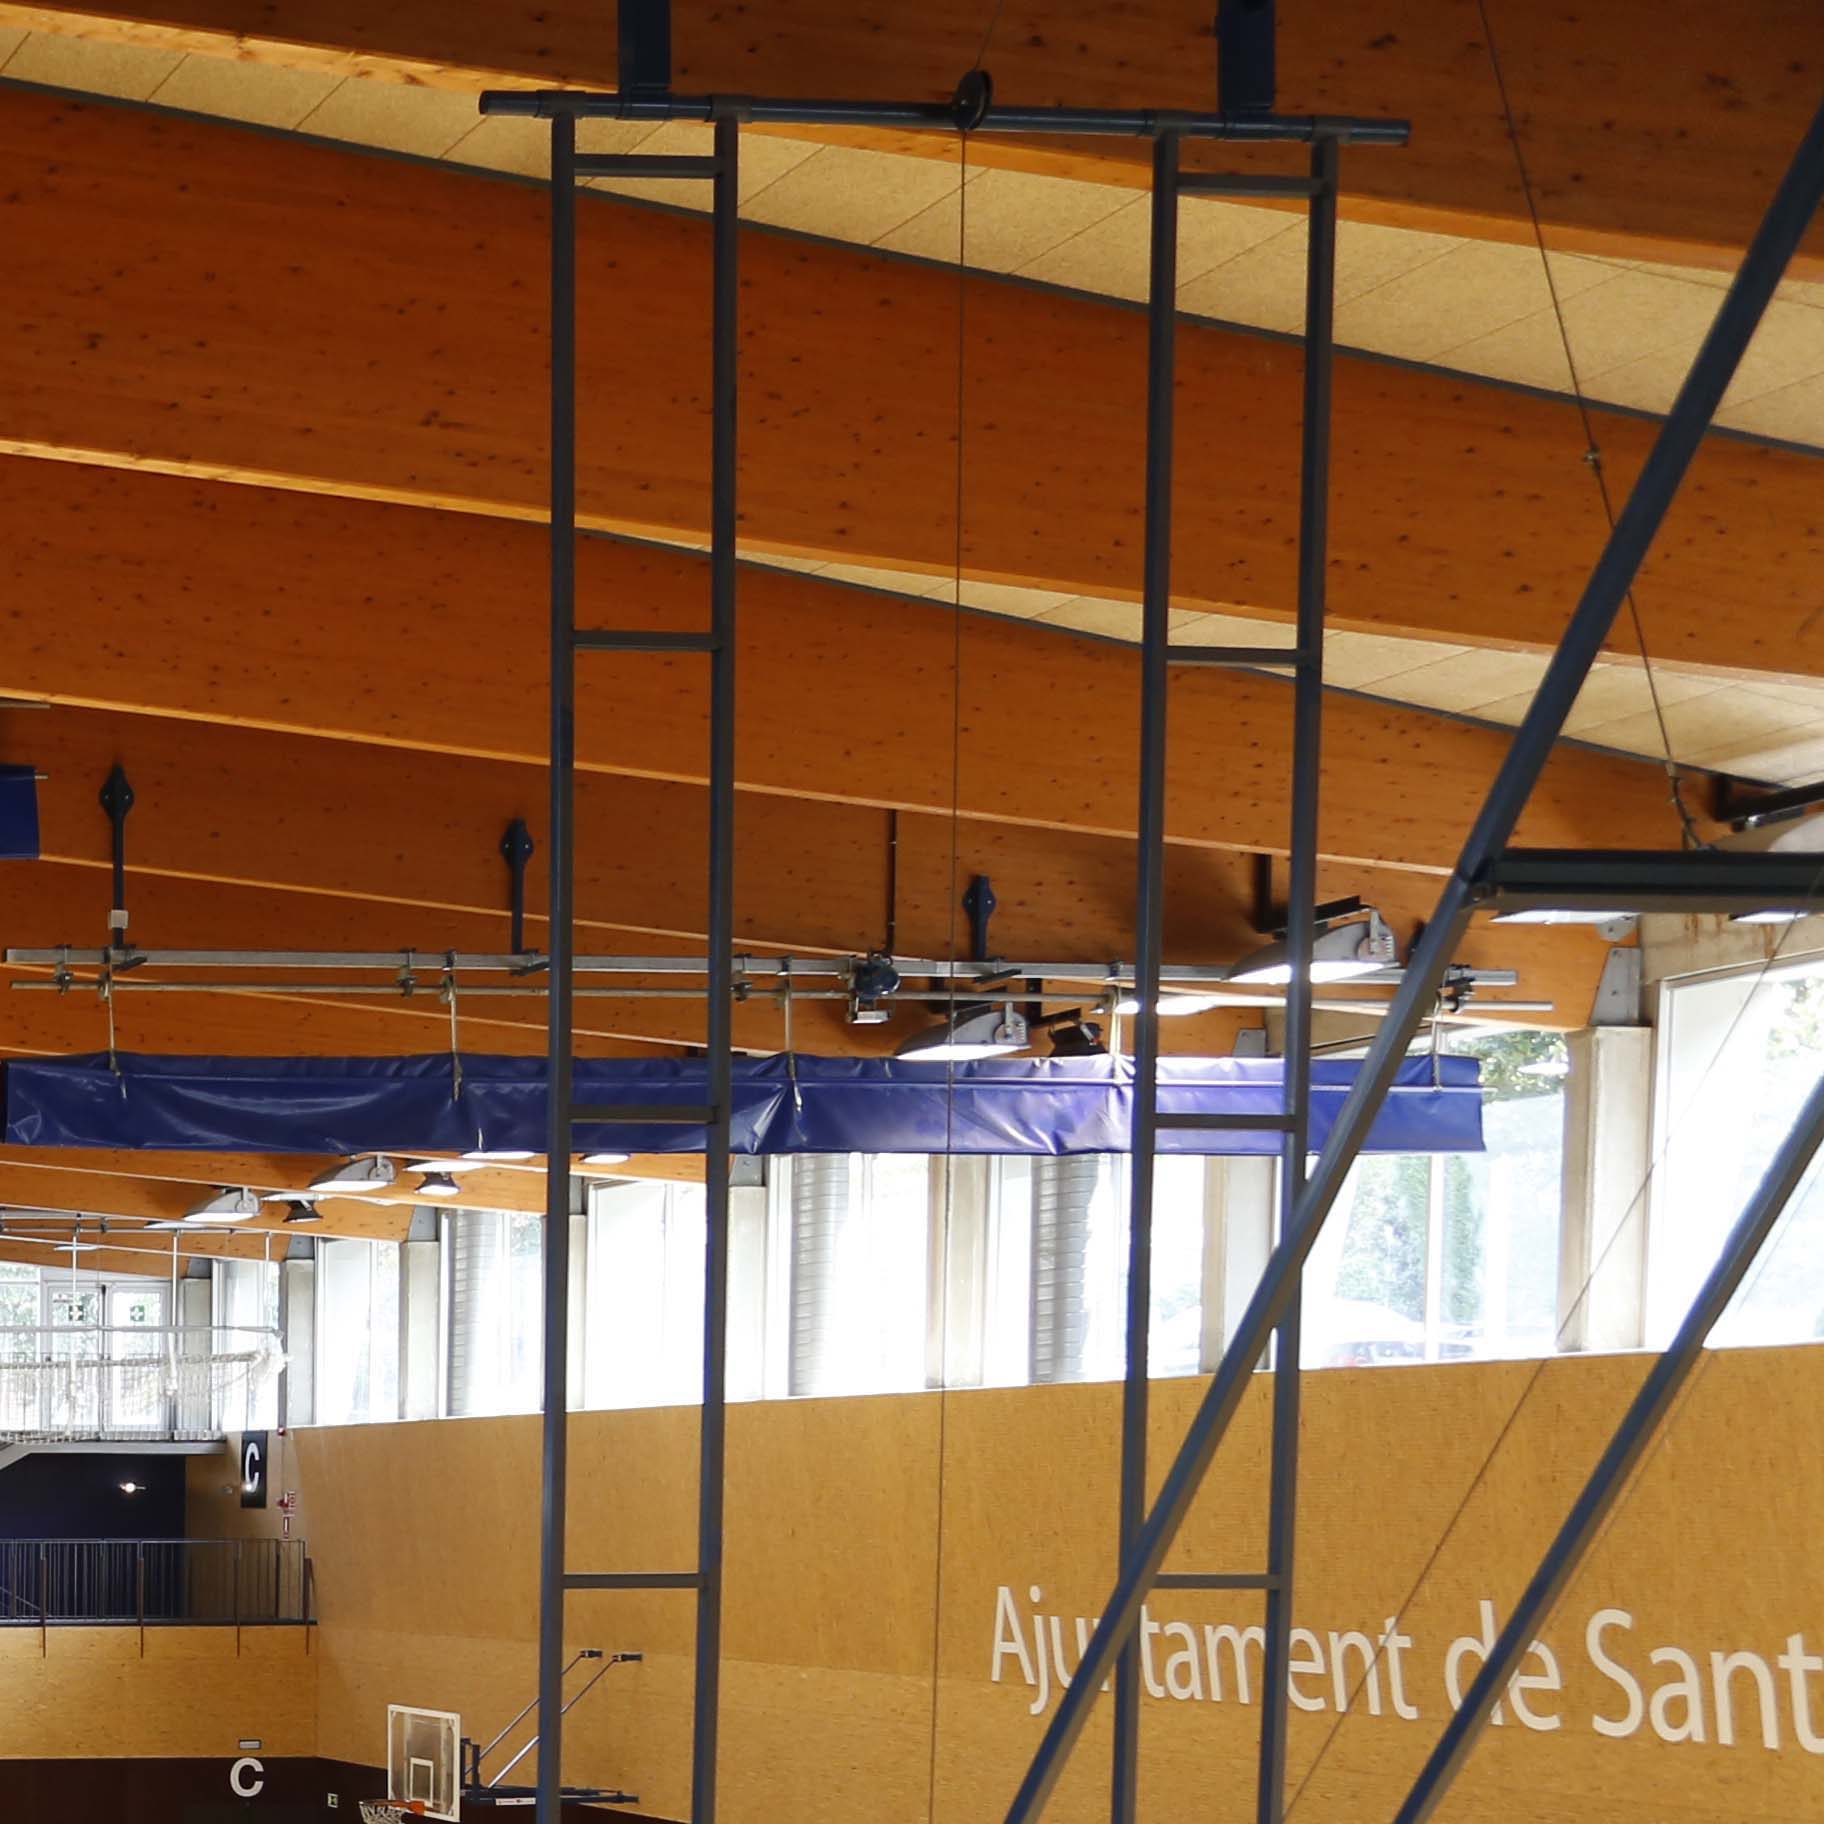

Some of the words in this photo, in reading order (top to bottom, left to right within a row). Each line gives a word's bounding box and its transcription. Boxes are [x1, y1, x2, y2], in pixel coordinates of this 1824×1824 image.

[245, 1442, 260, 1493] C
[989, 1585, 1418, 1722] Ajutament
[1585, 1608, 1824, 1754] Sant
[229, 1757, 265, 1798] C
